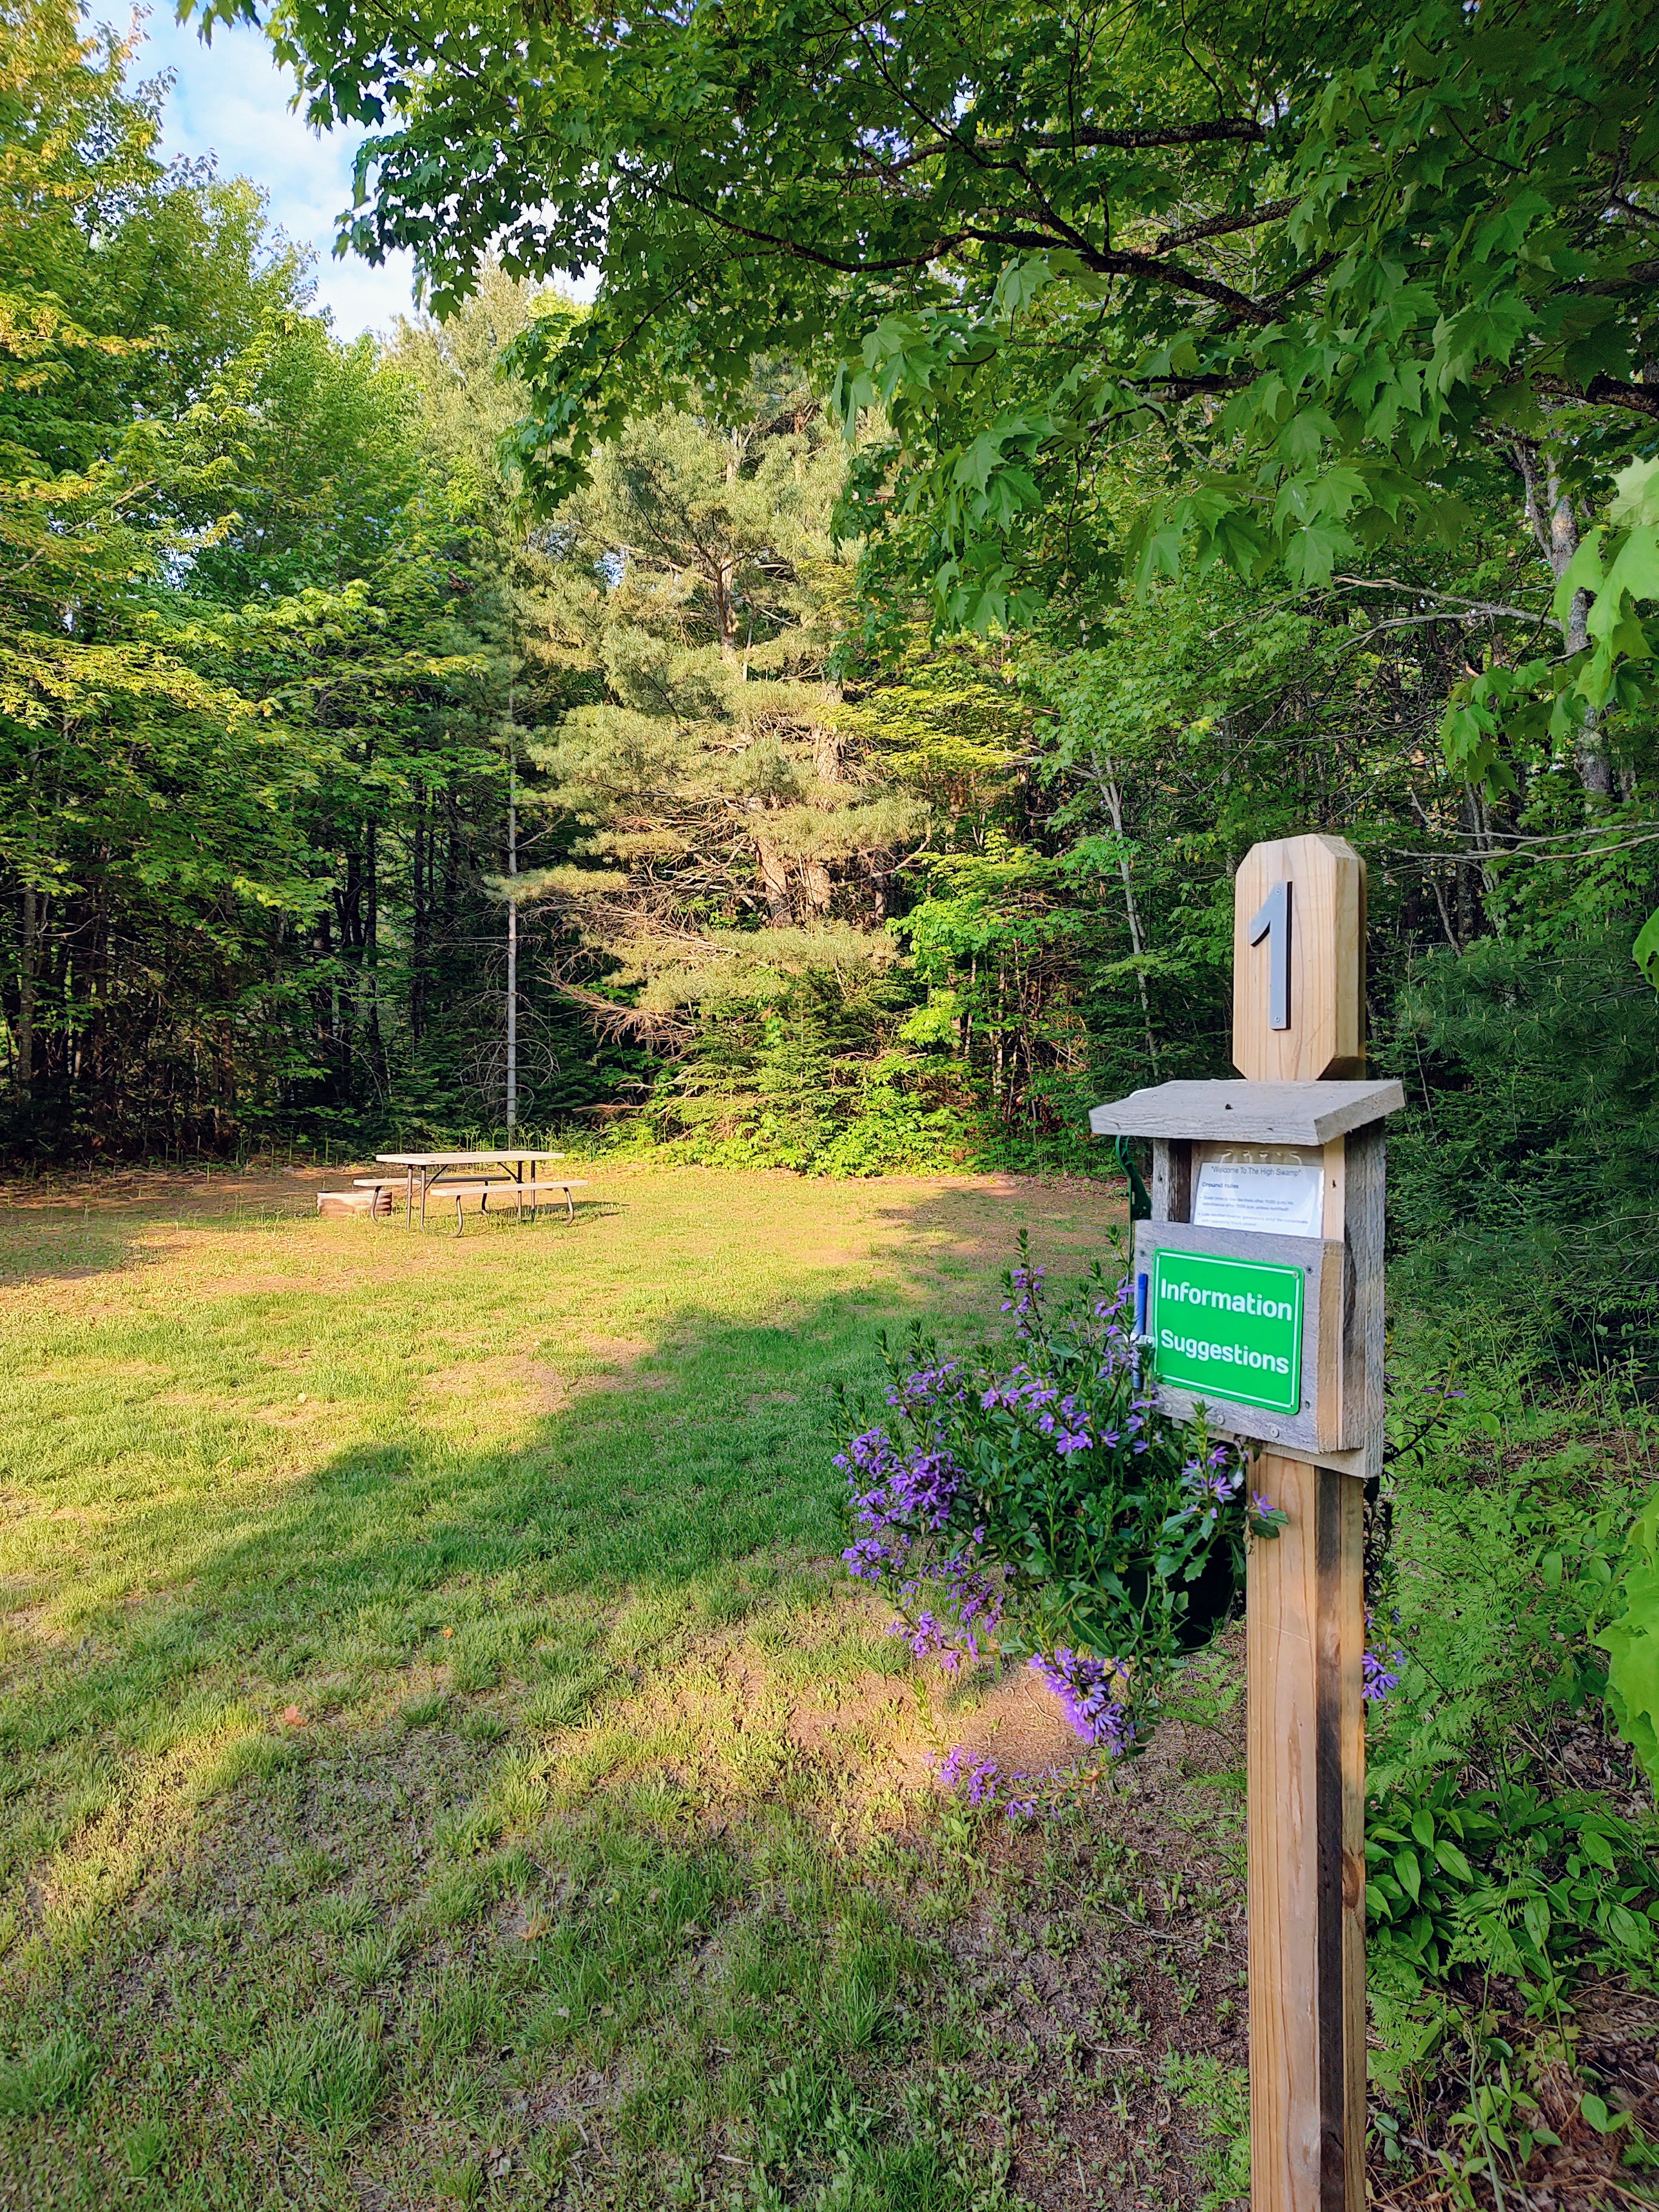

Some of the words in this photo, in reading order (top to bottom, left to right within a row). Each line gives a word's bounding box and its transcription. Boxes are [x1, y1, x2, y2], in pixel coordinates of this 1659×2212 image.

[1249, 880, 1291, 1030] 1
[1211, 1166, 1239, 1174] "Welcome
[1260, 1167, 1275, 1176] High
[1276, 1168, 1301, 1178] Swamp"
[1161, 1277, 1292, 1321] Information
[1161, 1329, 1290, 1375] Suggestions
